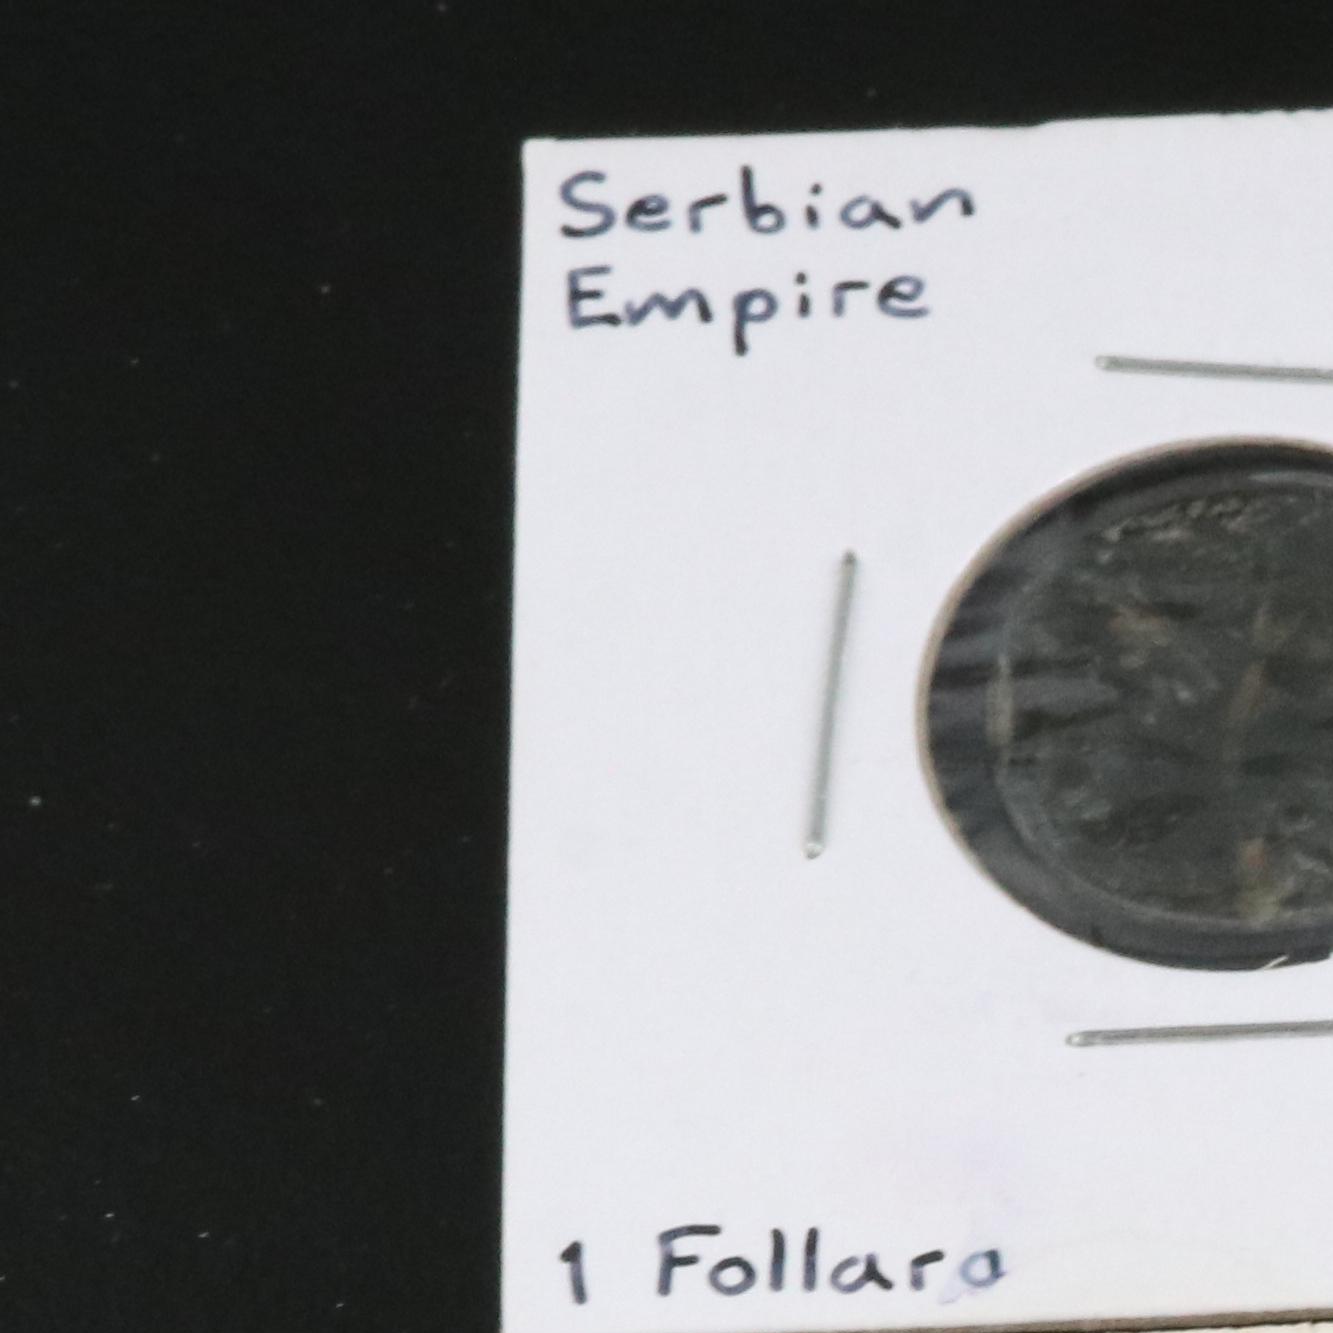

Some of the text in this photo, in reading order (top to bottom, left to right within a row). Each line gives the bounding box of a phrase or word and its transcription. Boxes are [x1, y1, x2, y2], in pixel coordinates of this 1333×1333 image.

[560, 165, 976, 239] Serbian
[567, 265, 929, 357] Empire
[560, 1241, 587, 1305] 1
